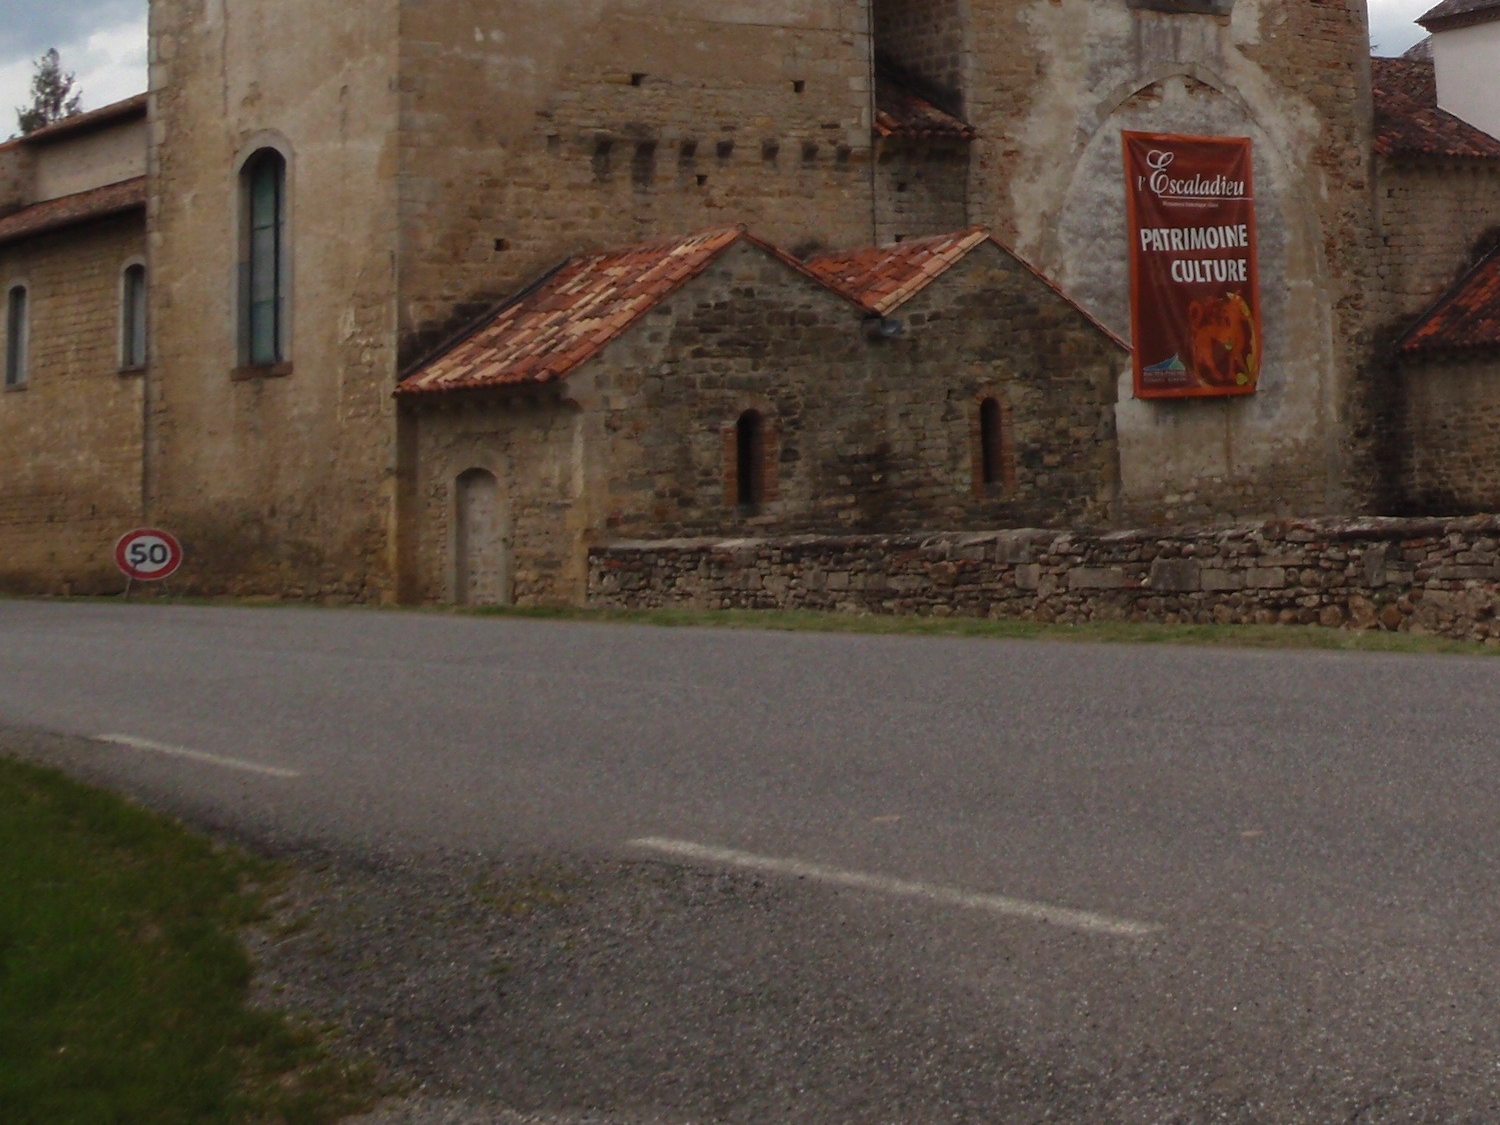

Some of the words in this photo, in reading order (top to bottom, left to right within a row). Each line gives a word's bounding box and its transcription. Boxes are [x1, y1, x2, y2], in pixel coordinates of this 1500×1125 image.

[1140, 224, 1248, 252] PATRIMOINE
[1171, 259, 1247, 283] CULTURE
[130, 543, 168, 564] 50
